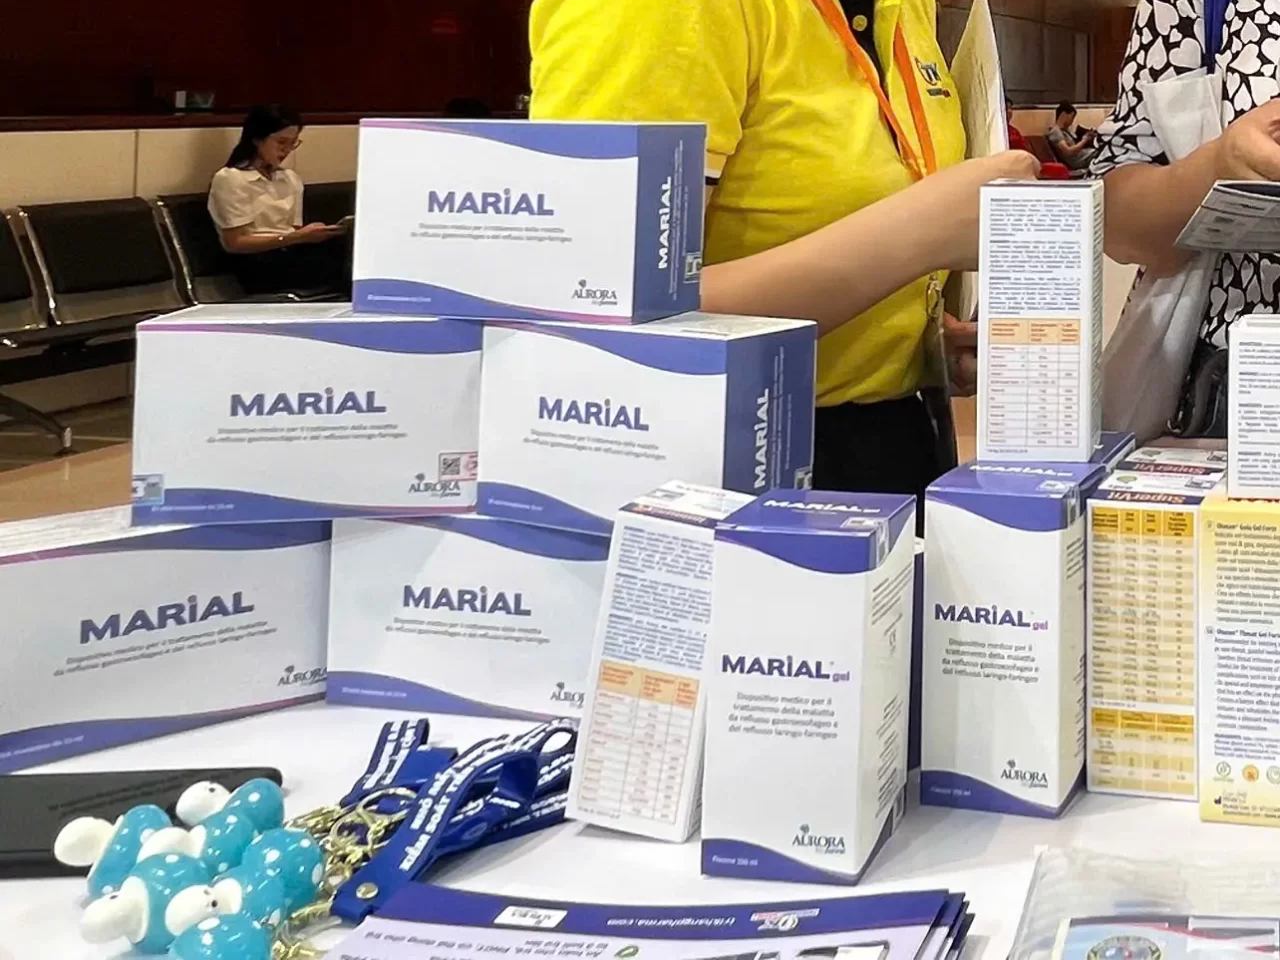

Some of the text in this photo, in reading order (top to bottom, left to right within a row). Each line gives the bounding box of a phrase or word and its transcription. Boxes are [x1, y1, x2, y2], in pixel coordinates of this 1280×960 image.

[1032, 620, 1049, 631] gel
[832, 671, 850, 682] gel
[1000, 769, 1049, 784] AURORA
[792, 834, 845, 849] AURORA
